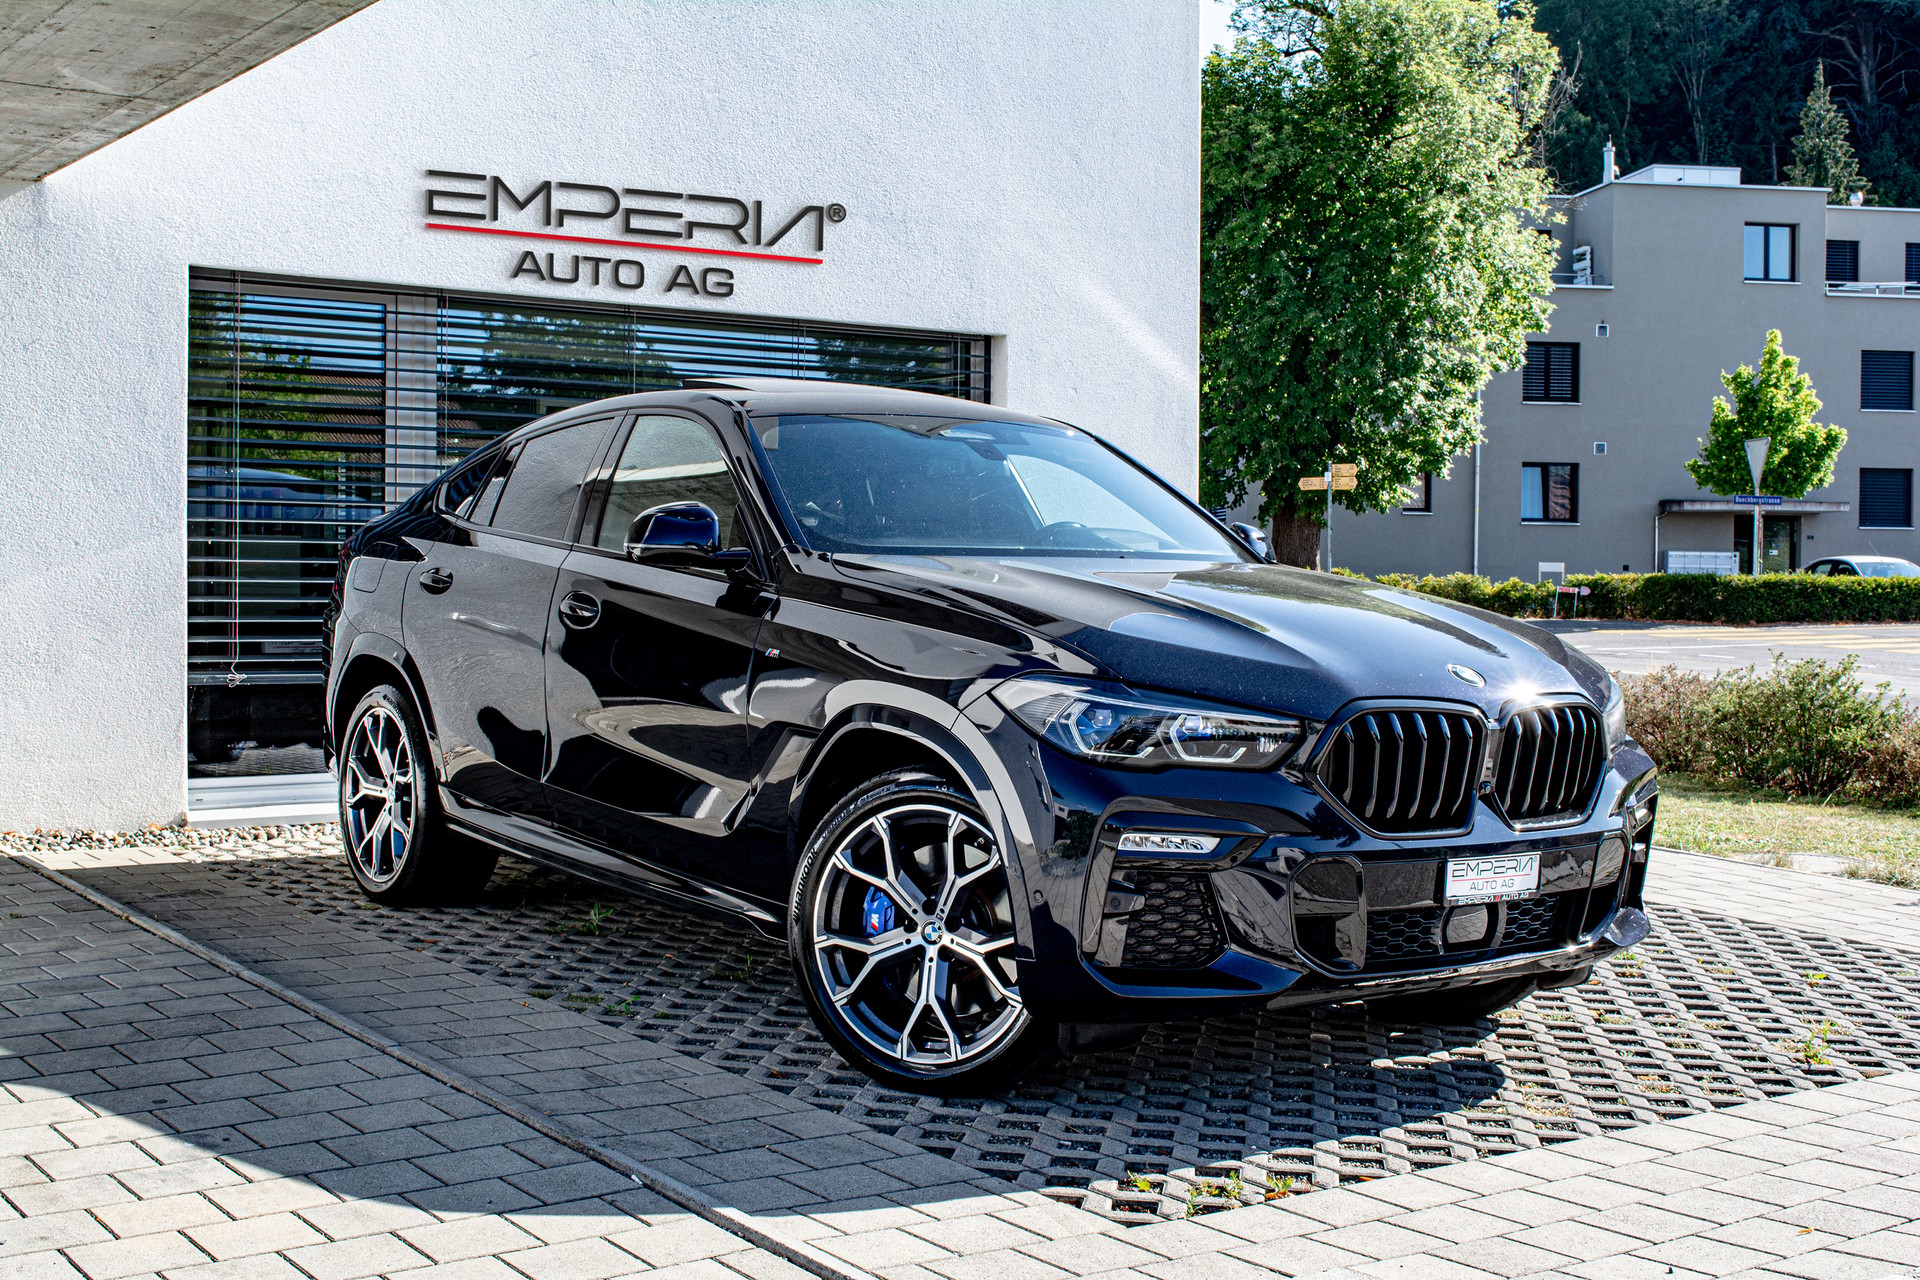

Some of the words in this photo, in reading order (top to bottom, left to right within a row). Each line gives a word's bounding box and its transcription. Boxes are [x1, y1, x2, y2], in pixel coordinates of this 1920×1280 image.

[512, 250, 645, 290] AUTO
[665, 264, 735, 298] AG
[1469, 880, 1498, 892] AUTO
[1501, 878, 1515, 890] AG
[1458, 896, 1494, 905] EMPERIA
[1501, 893, 1519, 901] AUTO
